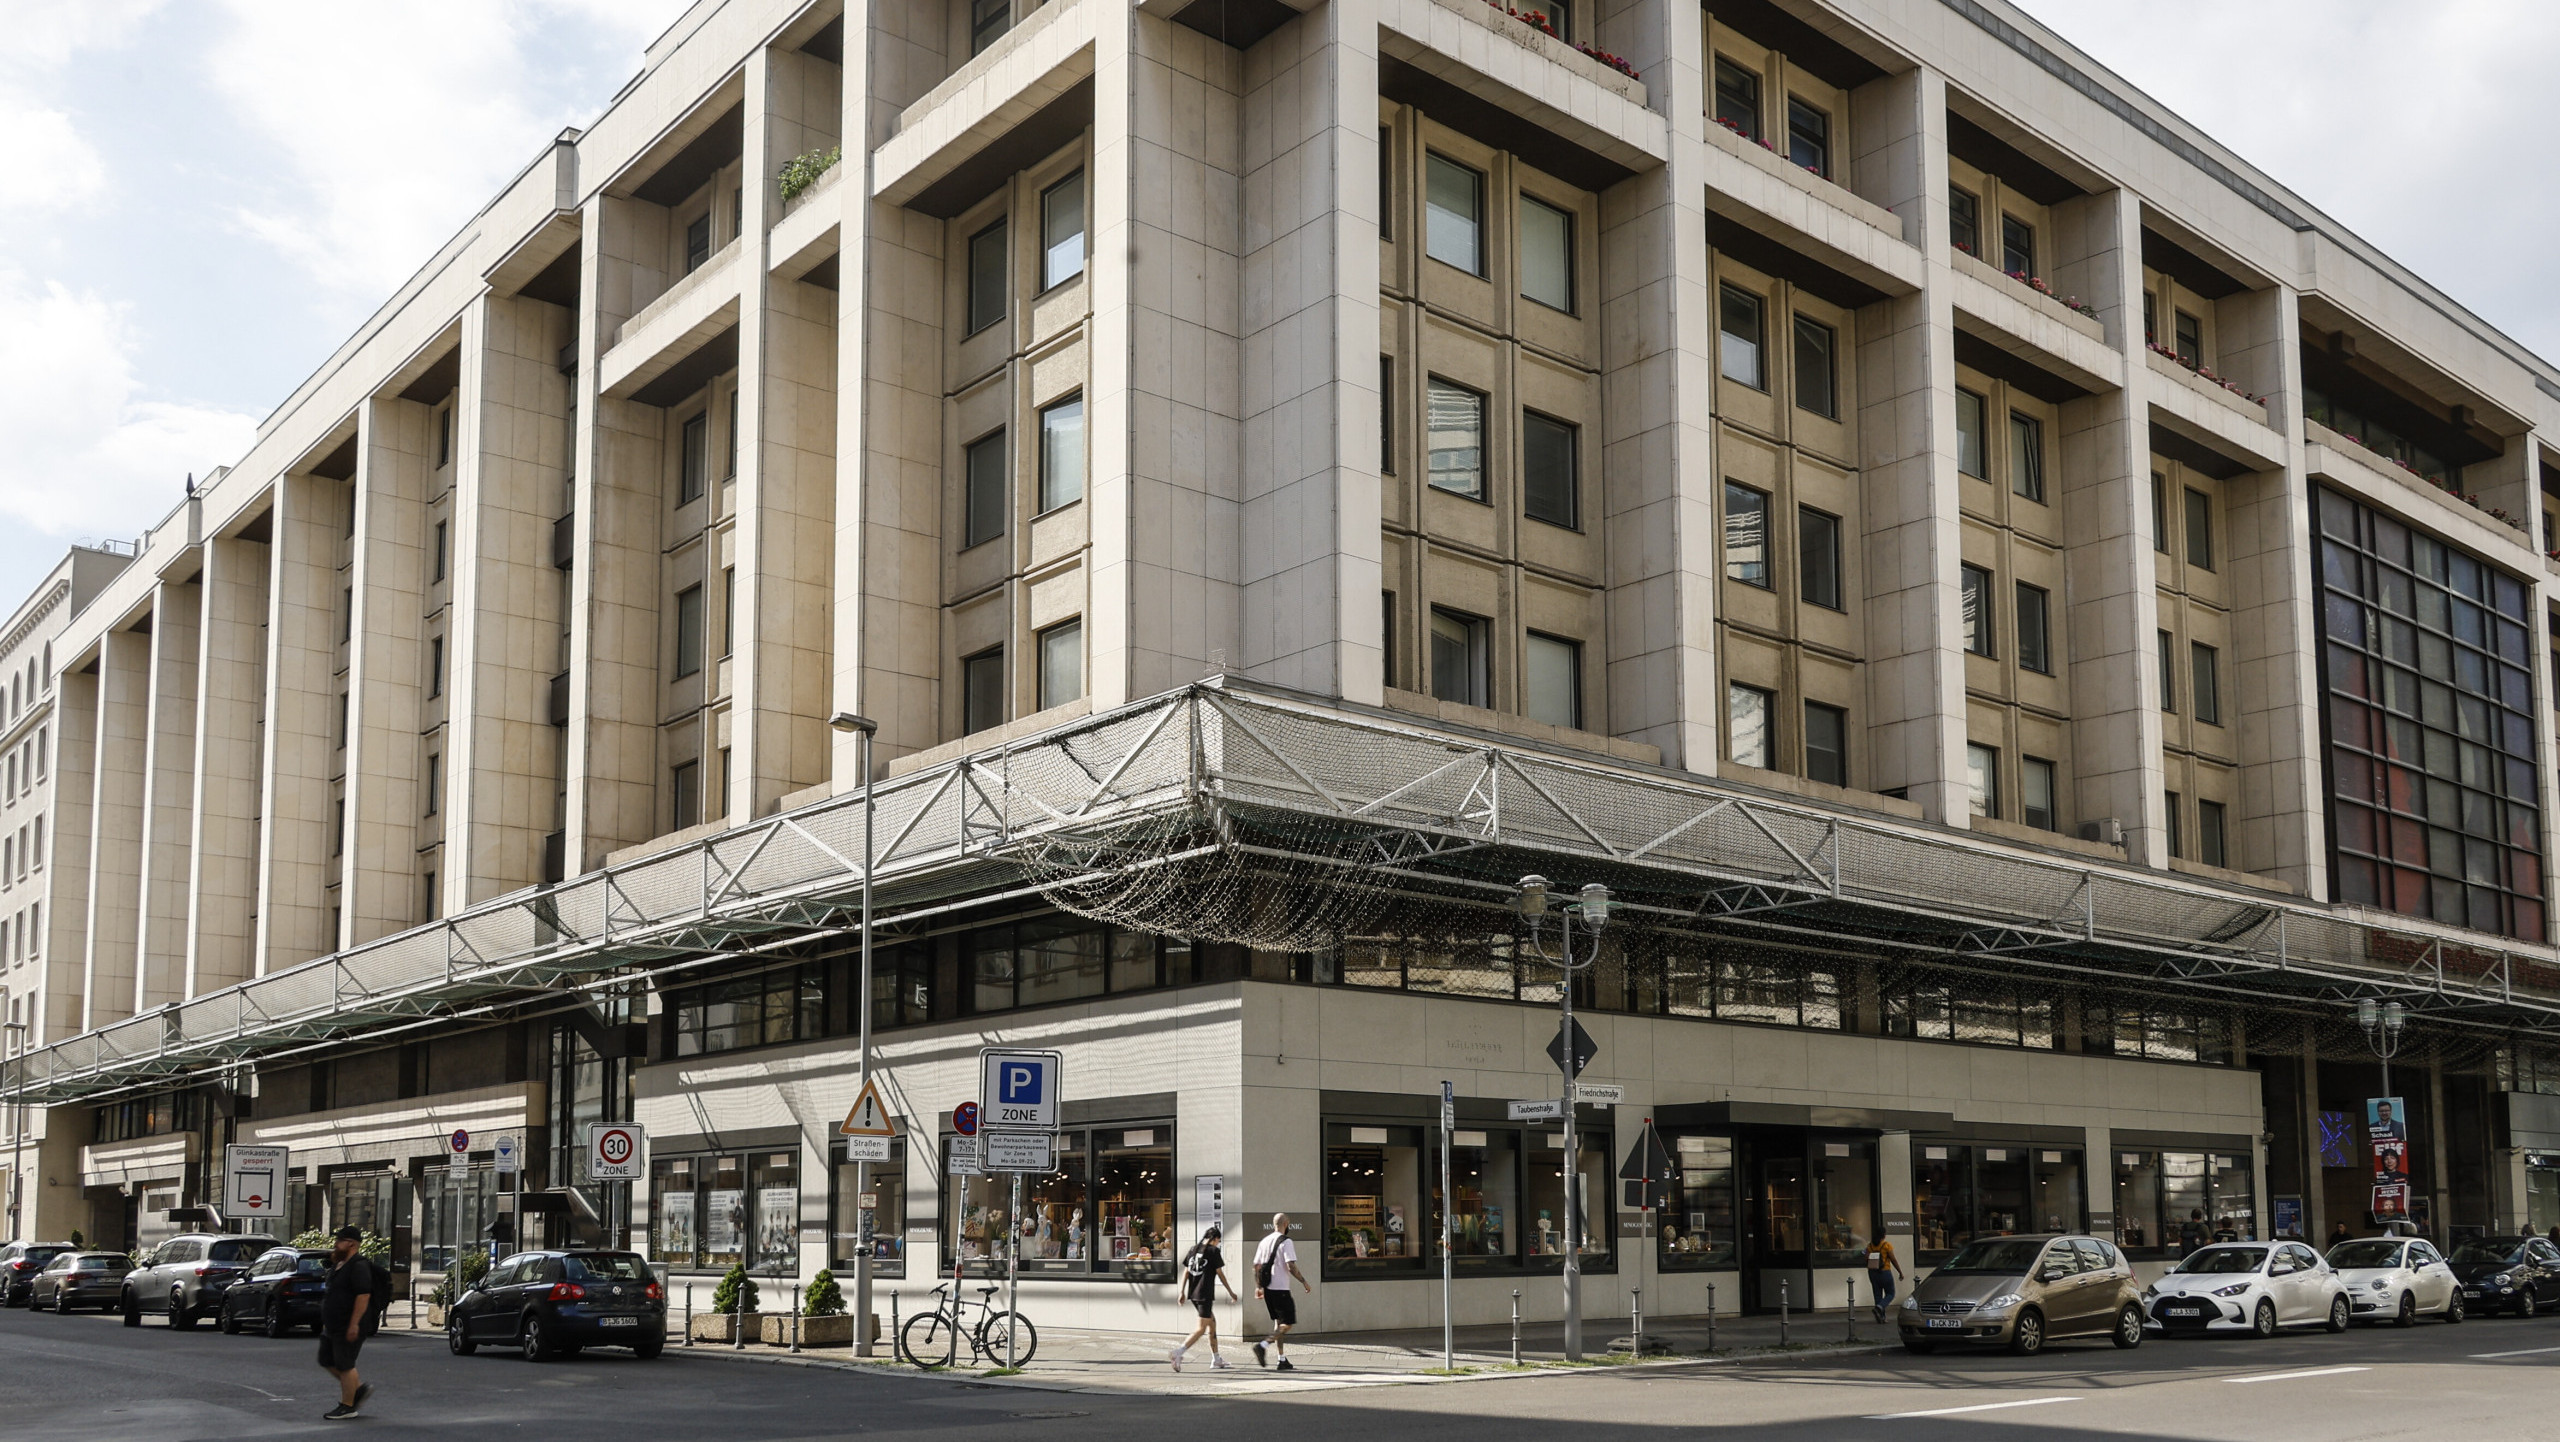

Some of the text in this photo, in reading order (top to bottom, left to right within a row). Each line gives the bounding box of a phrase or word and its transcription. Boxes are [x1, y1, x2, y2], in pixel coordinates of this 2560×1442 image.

[1009, 1068, 1032, 1098] P
[1579, 1087, 1619, 1099] Friedrichstraße
[1517, 1104, 1554, 1114] Taubenstraße
[1002, 1109, 1037, 1121] ZONE
[607, 1139, 626, 1155] 30
[854, 1140, 884, 1148] Straßen-
[236, 1149, 280, 1157] Glinkastraße
[854, 1148, 883, 1157] schäden
[603, 1165, 629, 1175] ZONE
